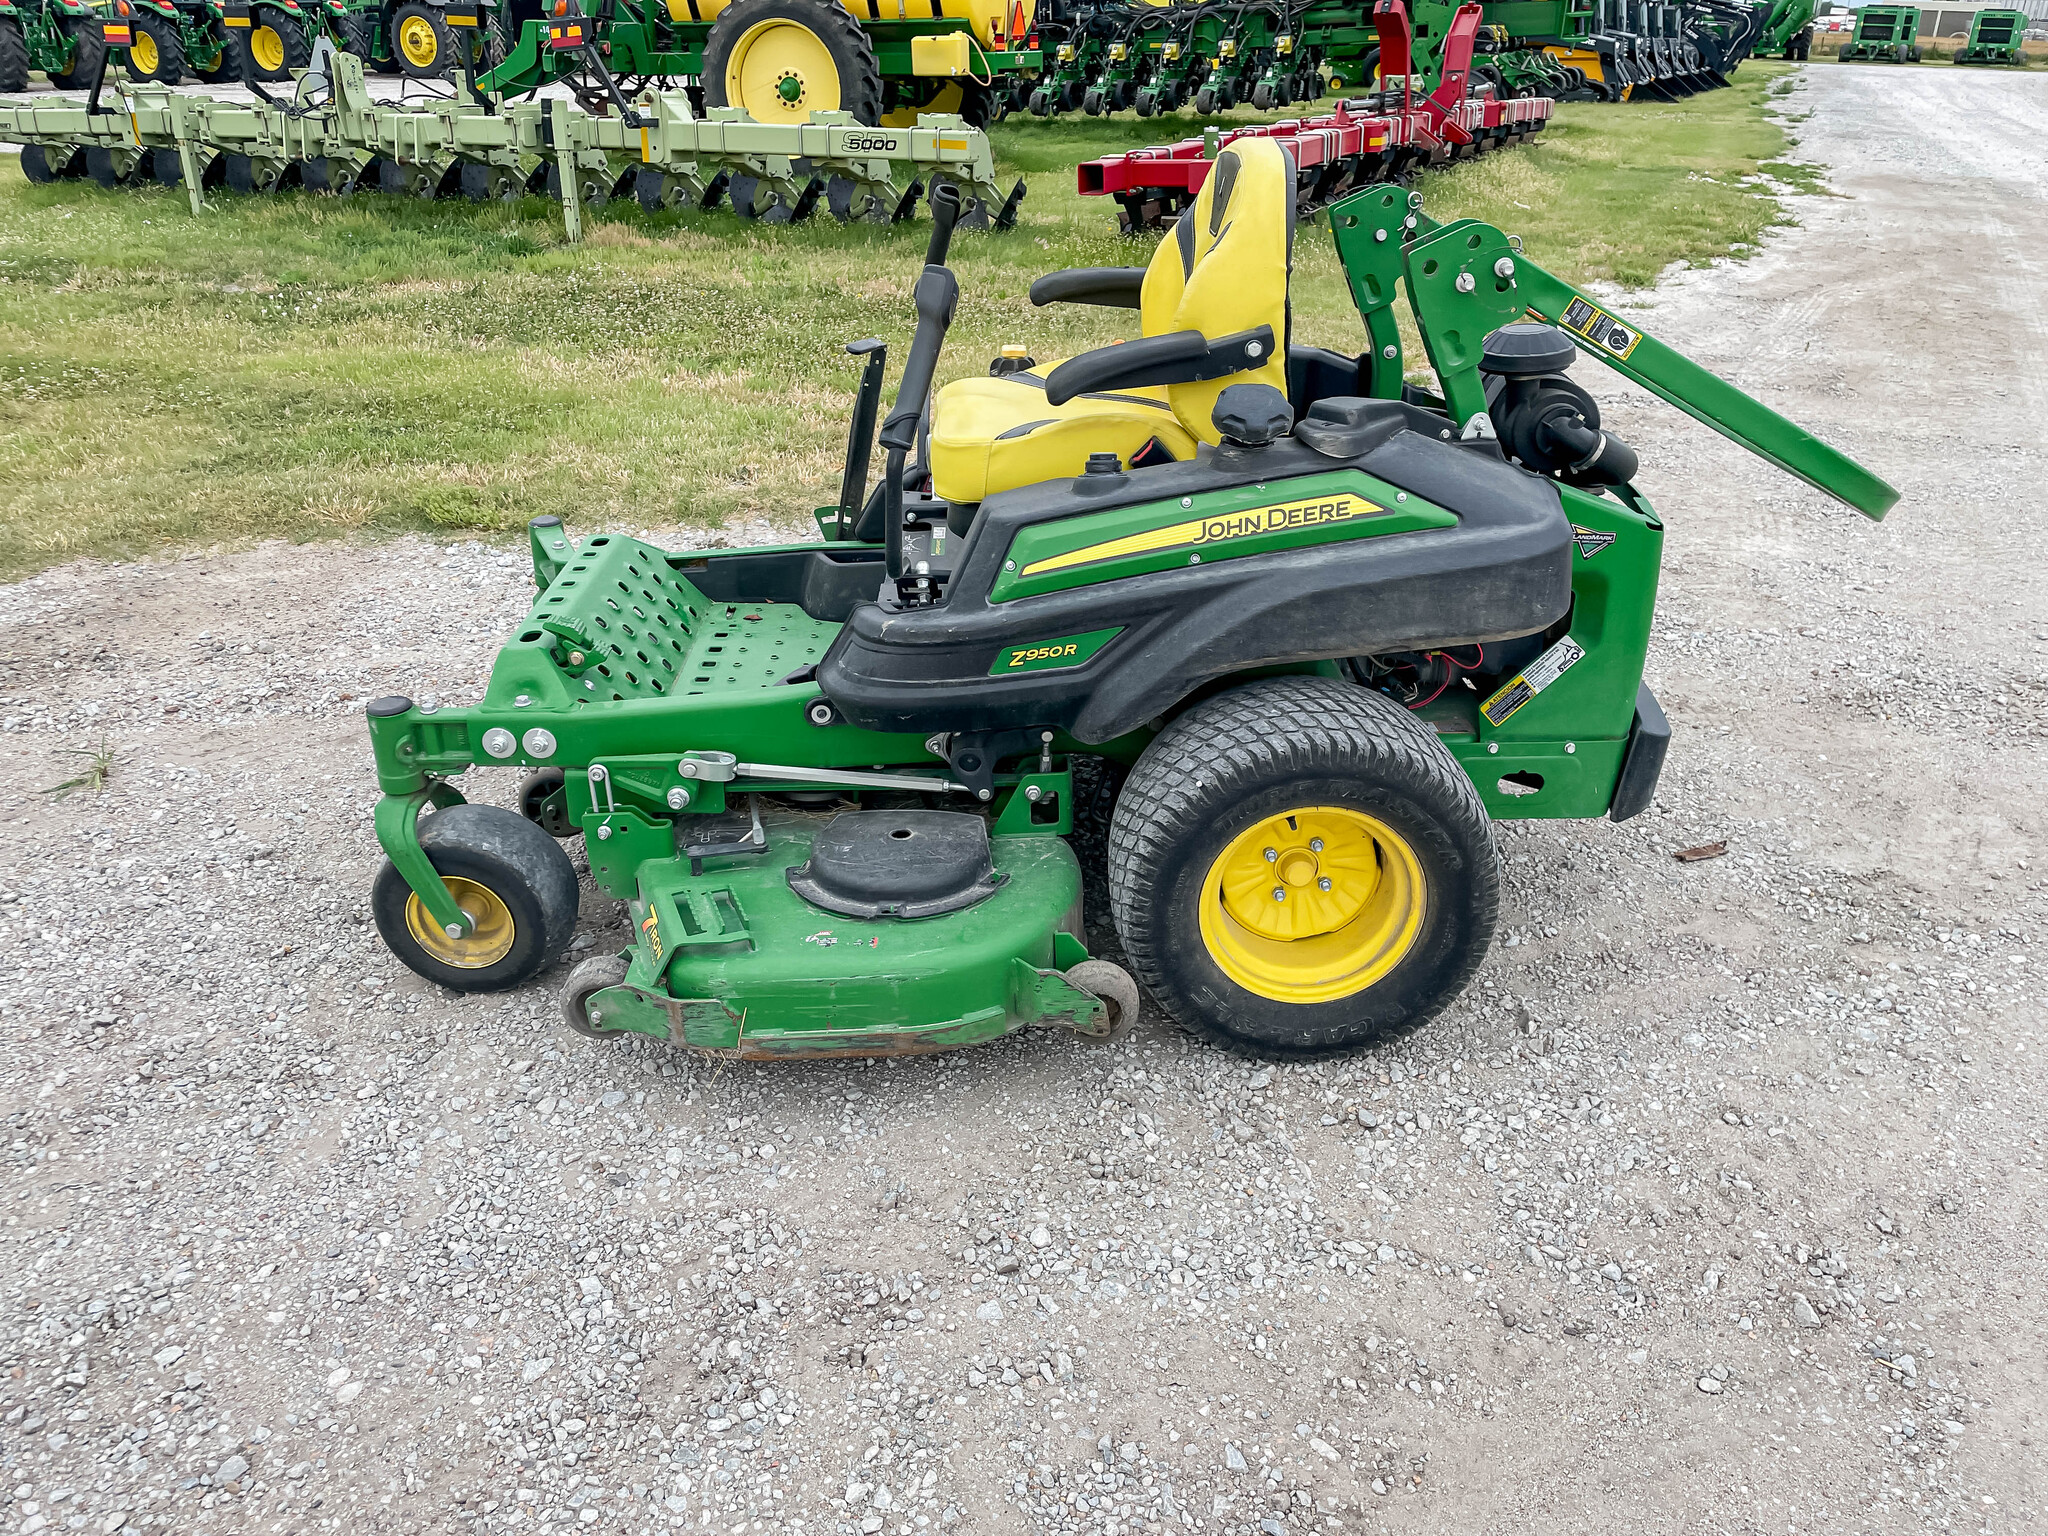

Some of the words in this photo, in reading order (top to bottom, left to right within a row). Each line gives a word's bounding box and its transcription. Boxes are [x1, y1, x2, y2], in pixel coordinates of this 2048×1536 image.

[848, 138, 898, 151] 5000
[1193, 515, 1261, 542] JOHN
[1267, 501, 1351, 529] DEERE
[1008, 643, 1079, 667] Z950R
